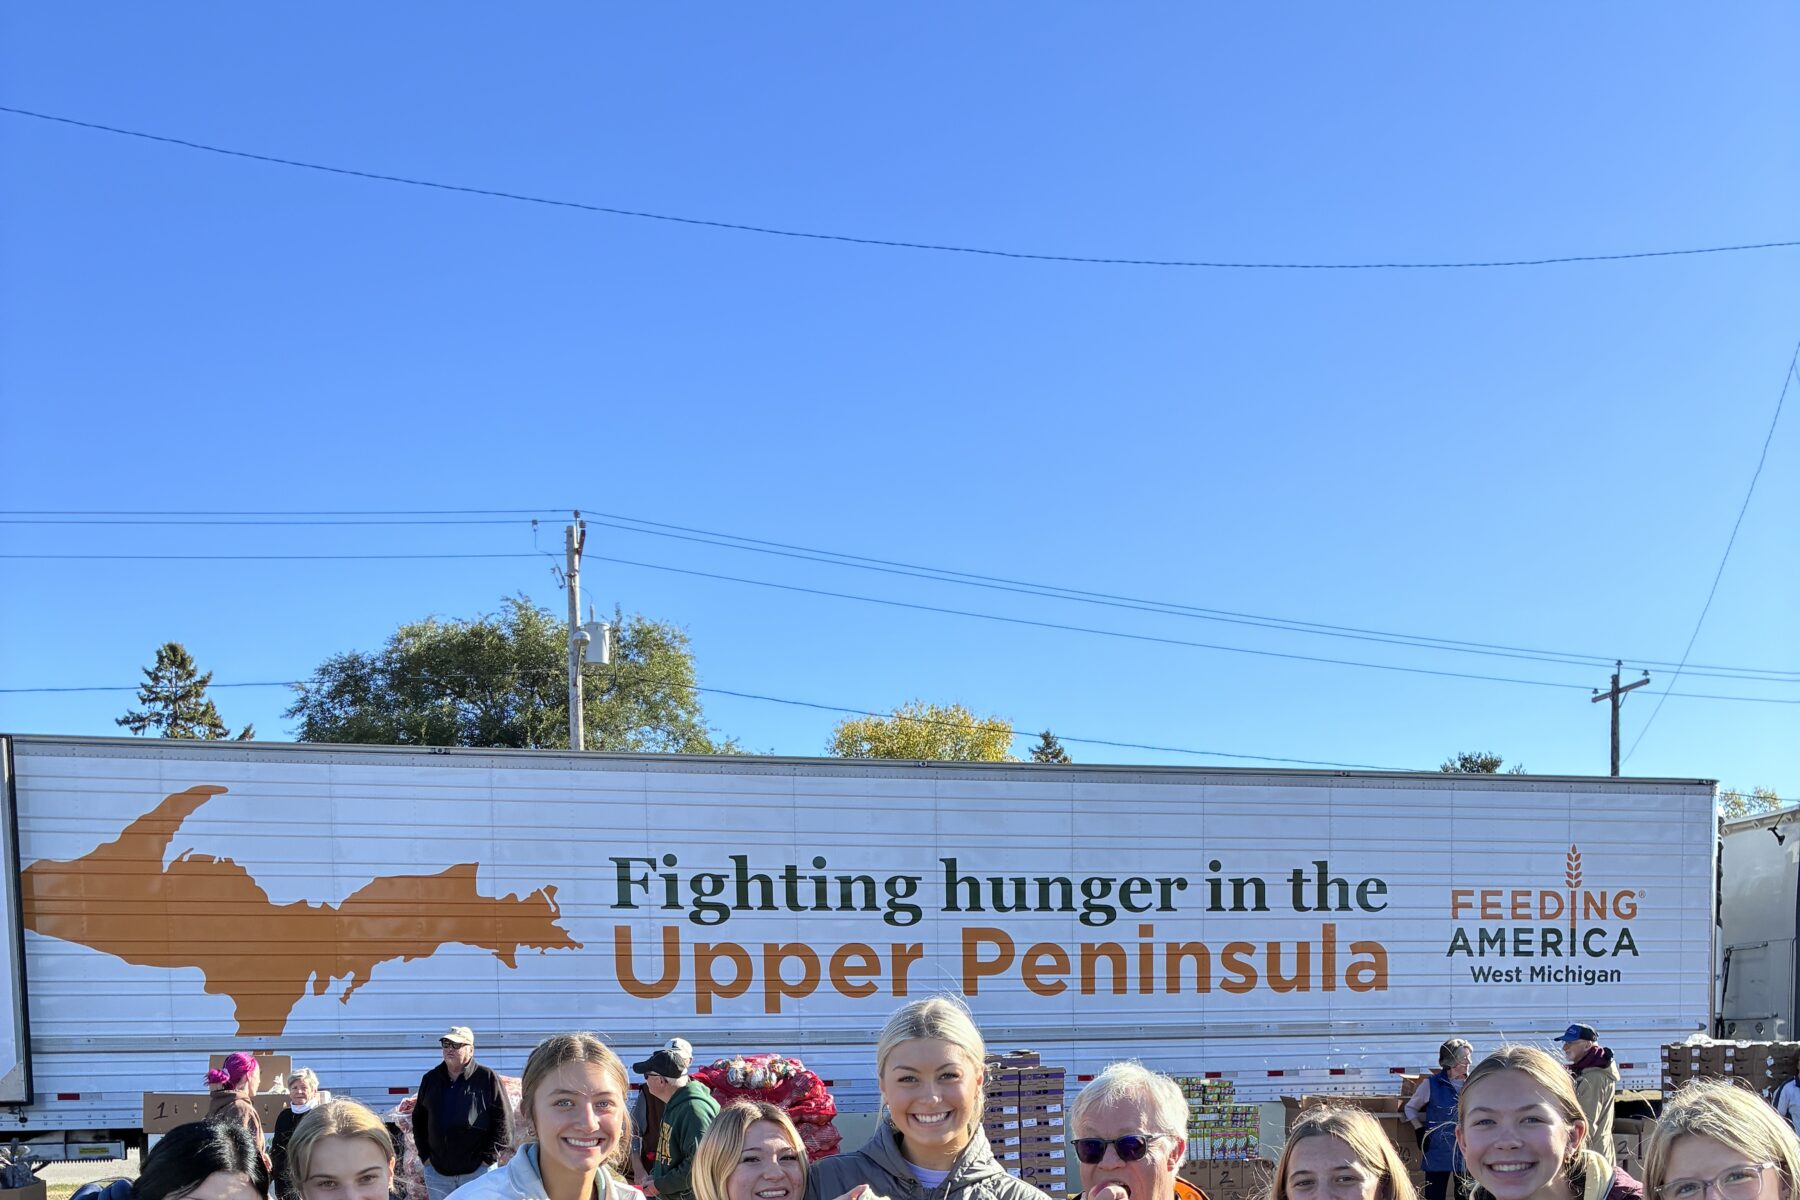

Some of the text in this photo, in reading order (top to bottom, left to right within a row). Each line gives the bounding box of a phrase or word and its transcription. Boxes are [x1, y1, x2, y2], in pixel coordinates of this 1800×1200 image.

[609, 853, 1388, 926] Fighting hunger in the
[1446, 927, 1639, 957] AMERICA
[614, 923, 1389, 1014] Upper Peninsula
[1470, 965, 1621, 985] West Michigan
